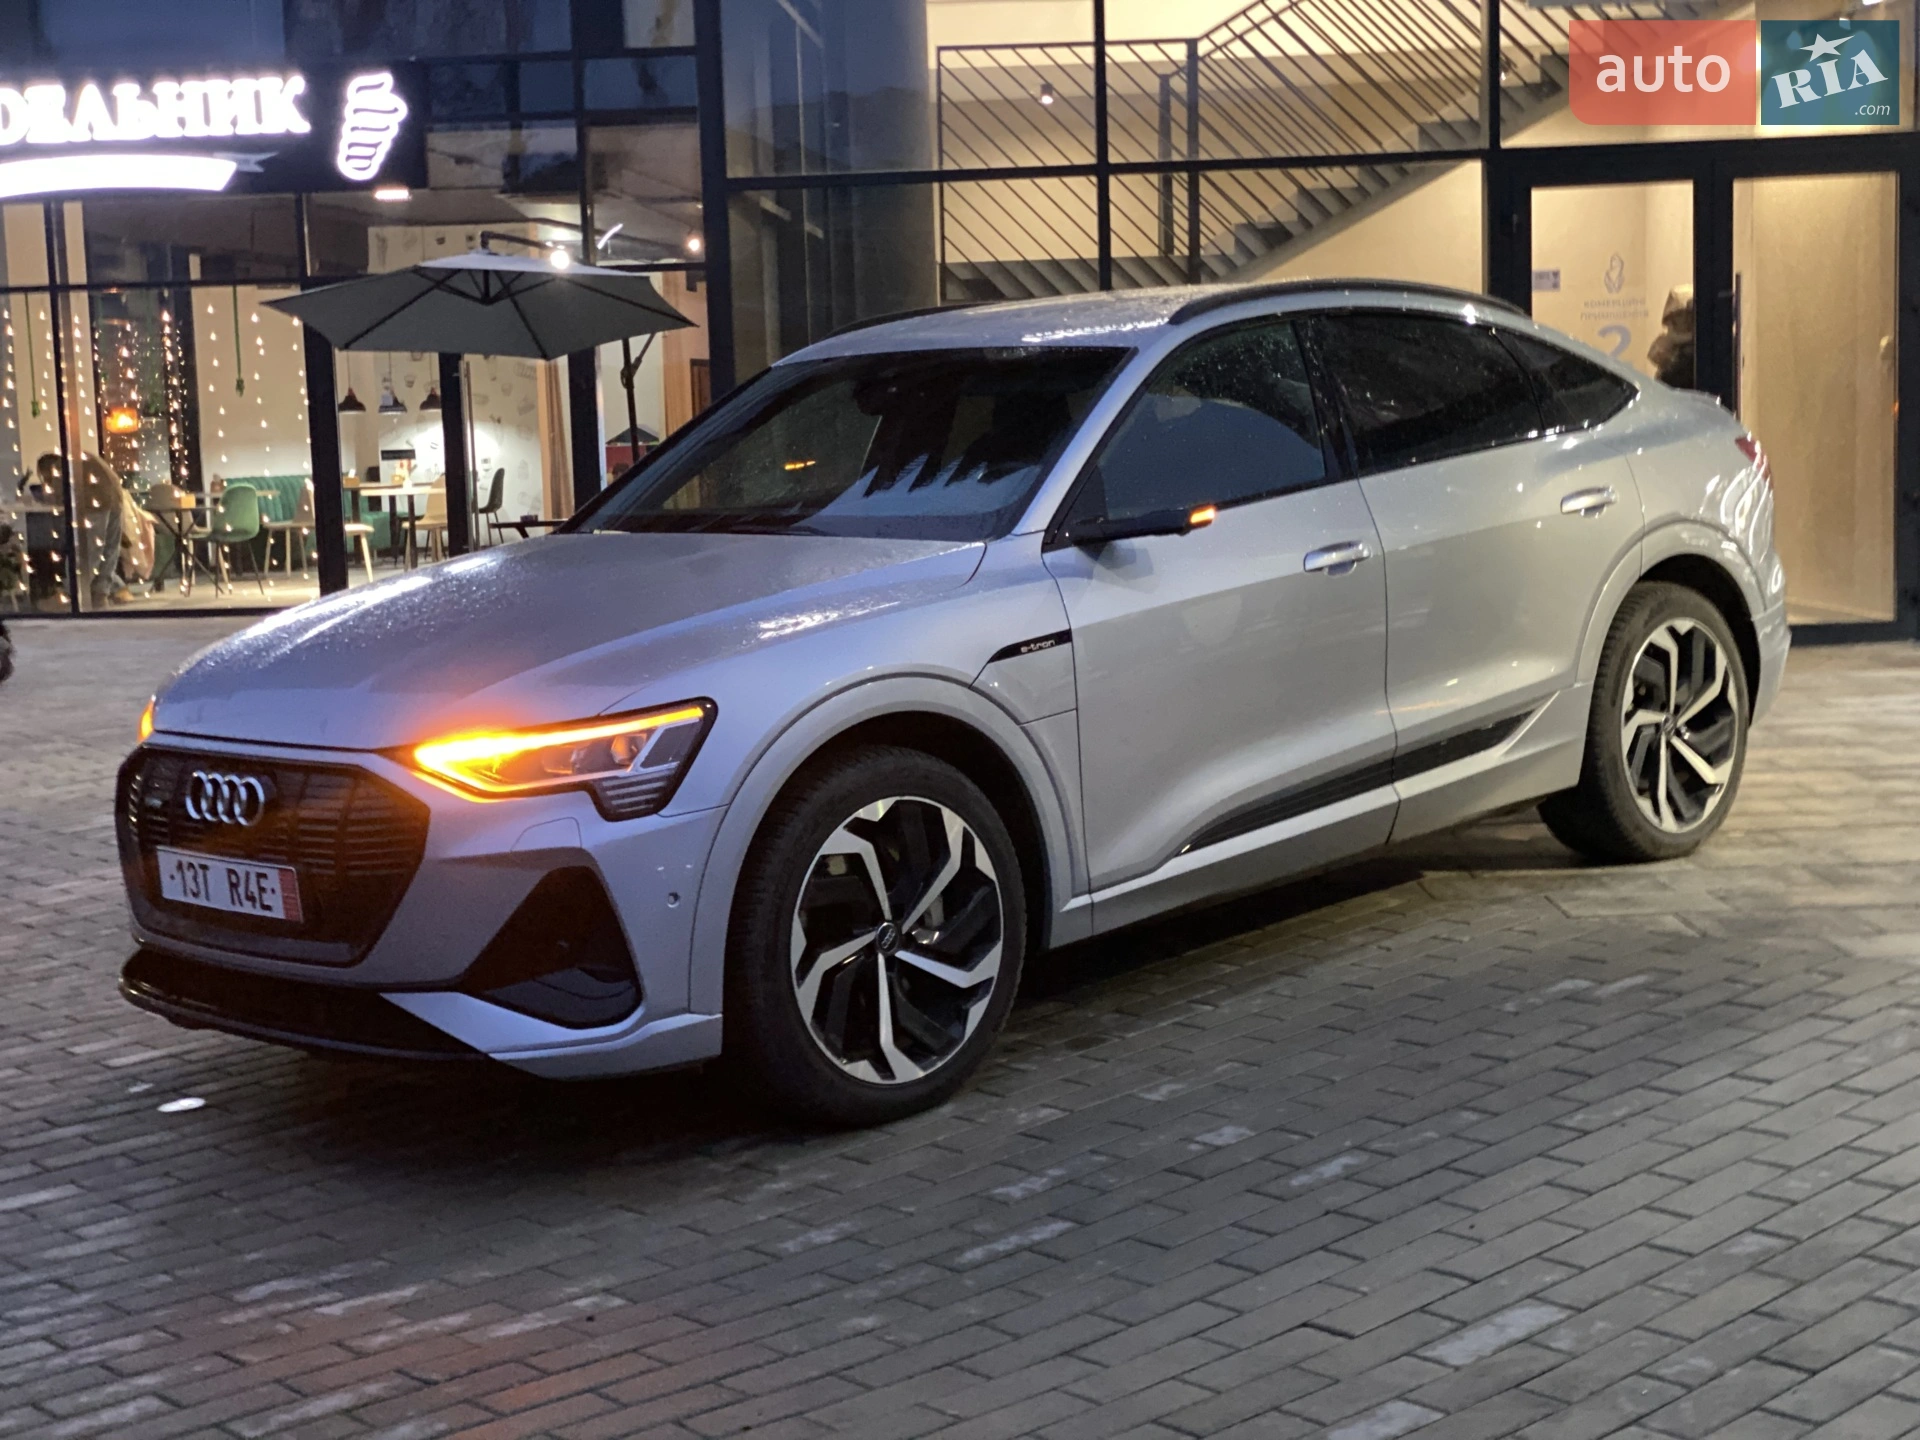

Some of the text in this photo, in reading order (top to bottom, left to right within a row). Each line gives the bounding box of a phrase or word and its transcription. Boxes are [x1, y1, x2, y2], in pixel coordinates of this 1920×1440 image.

[1598, 324, 1632, 361] 2
[1020, 639, 1056, 653] e-tron
[226, 867, 273, 912] R4E
